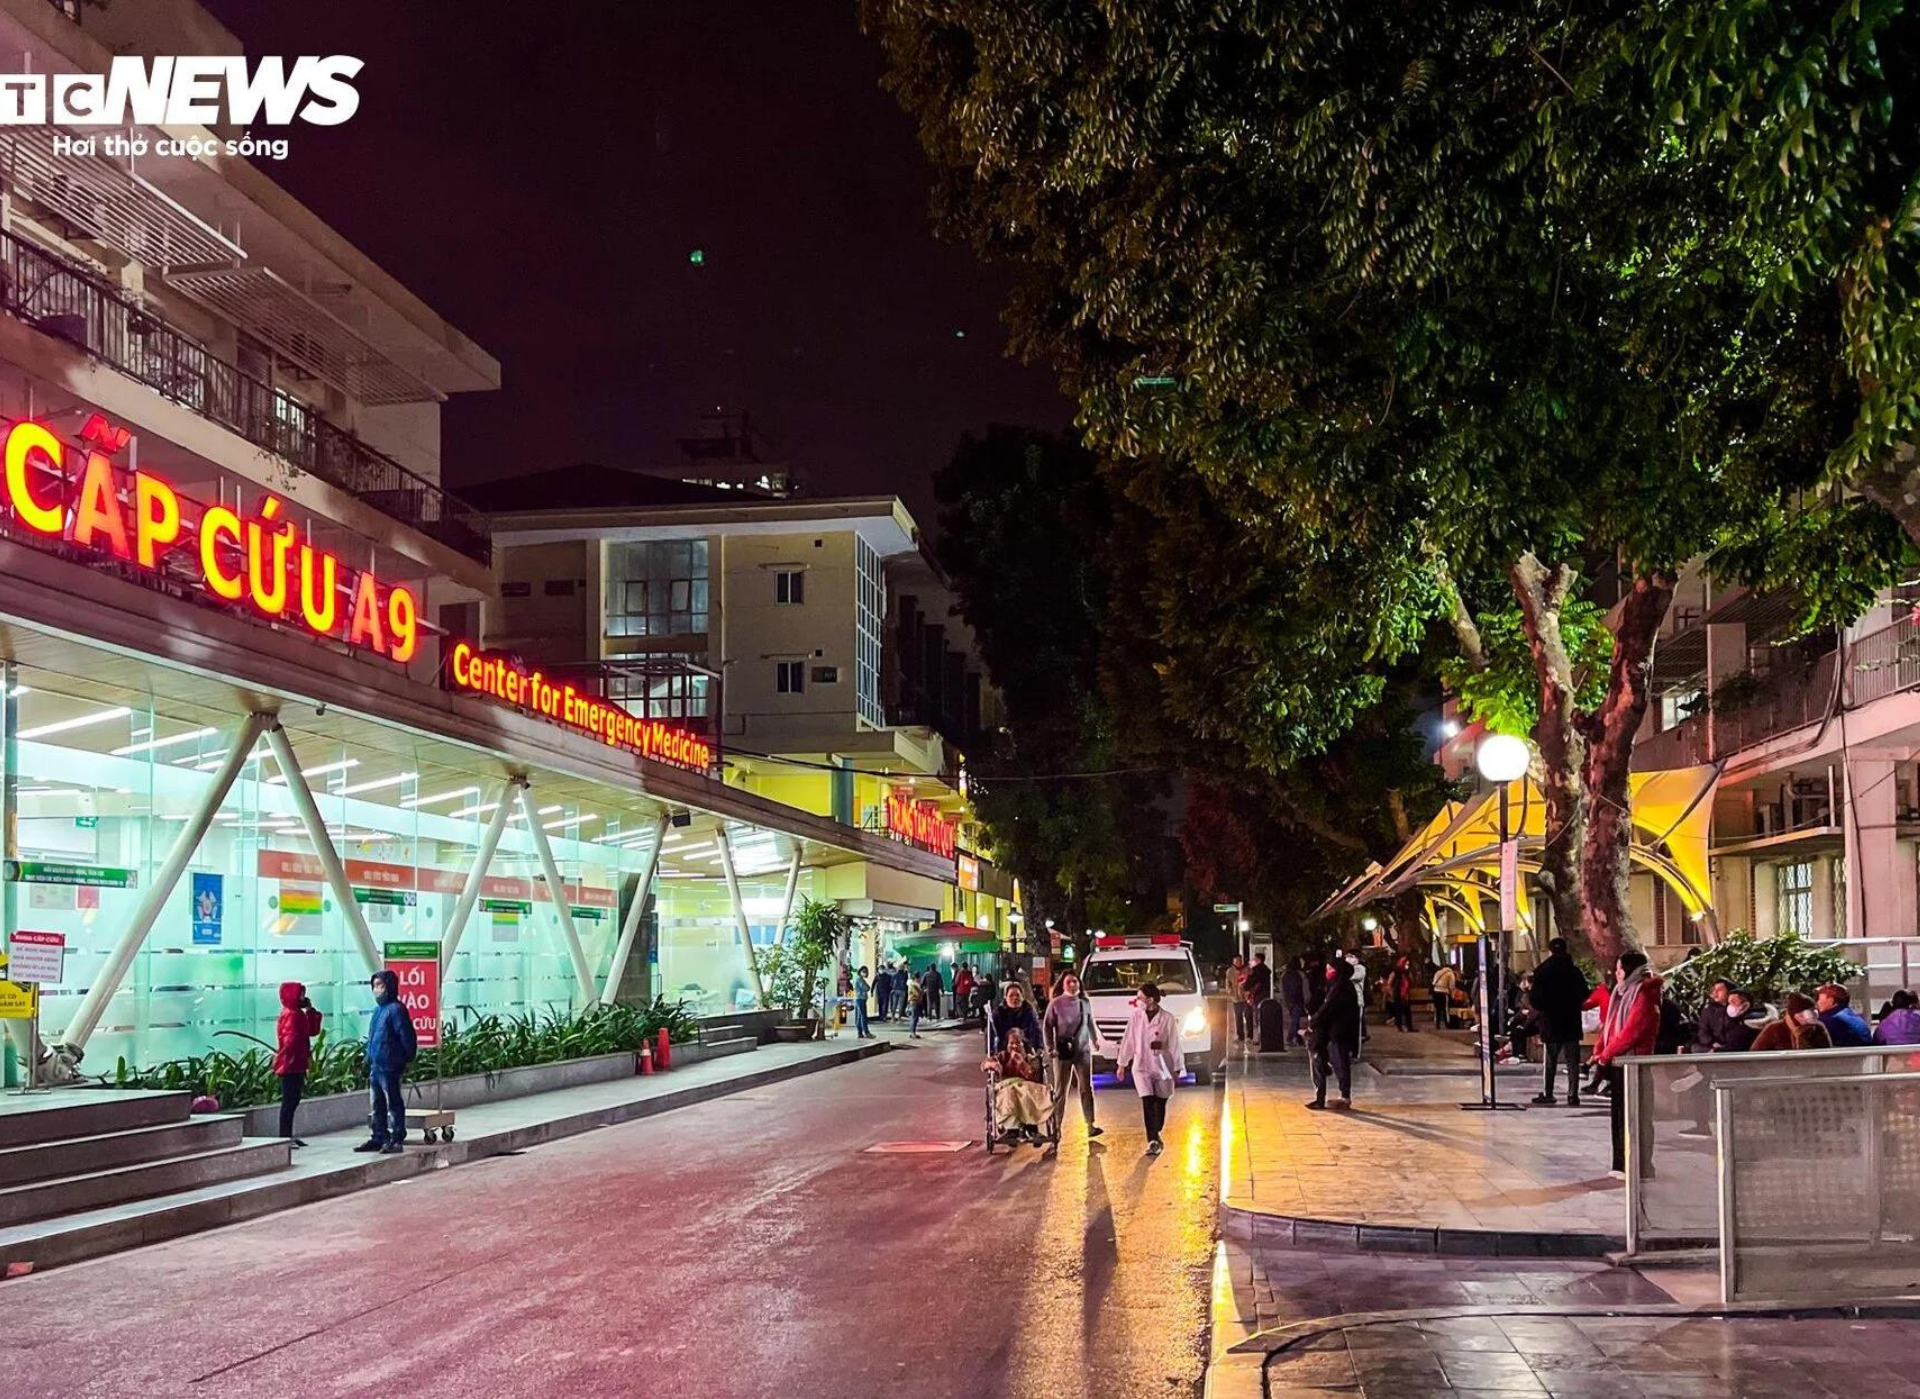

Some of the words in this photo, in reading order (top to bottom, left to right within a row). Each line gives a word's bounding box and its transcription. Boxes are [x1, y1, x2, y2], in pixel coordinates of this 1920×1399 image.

[5, 413, 181, 569] CẤP
[200, 496, 337, 634] CỨU
[350, 570, 417, 664] A9
[453, 643, 529, 704] Center
[530, 672, 562, 717] for
[564, 686, 651, 757] Emergency
[652, 722, 710, 769] Medicine
[399, 966, 425, 985] LỐI
